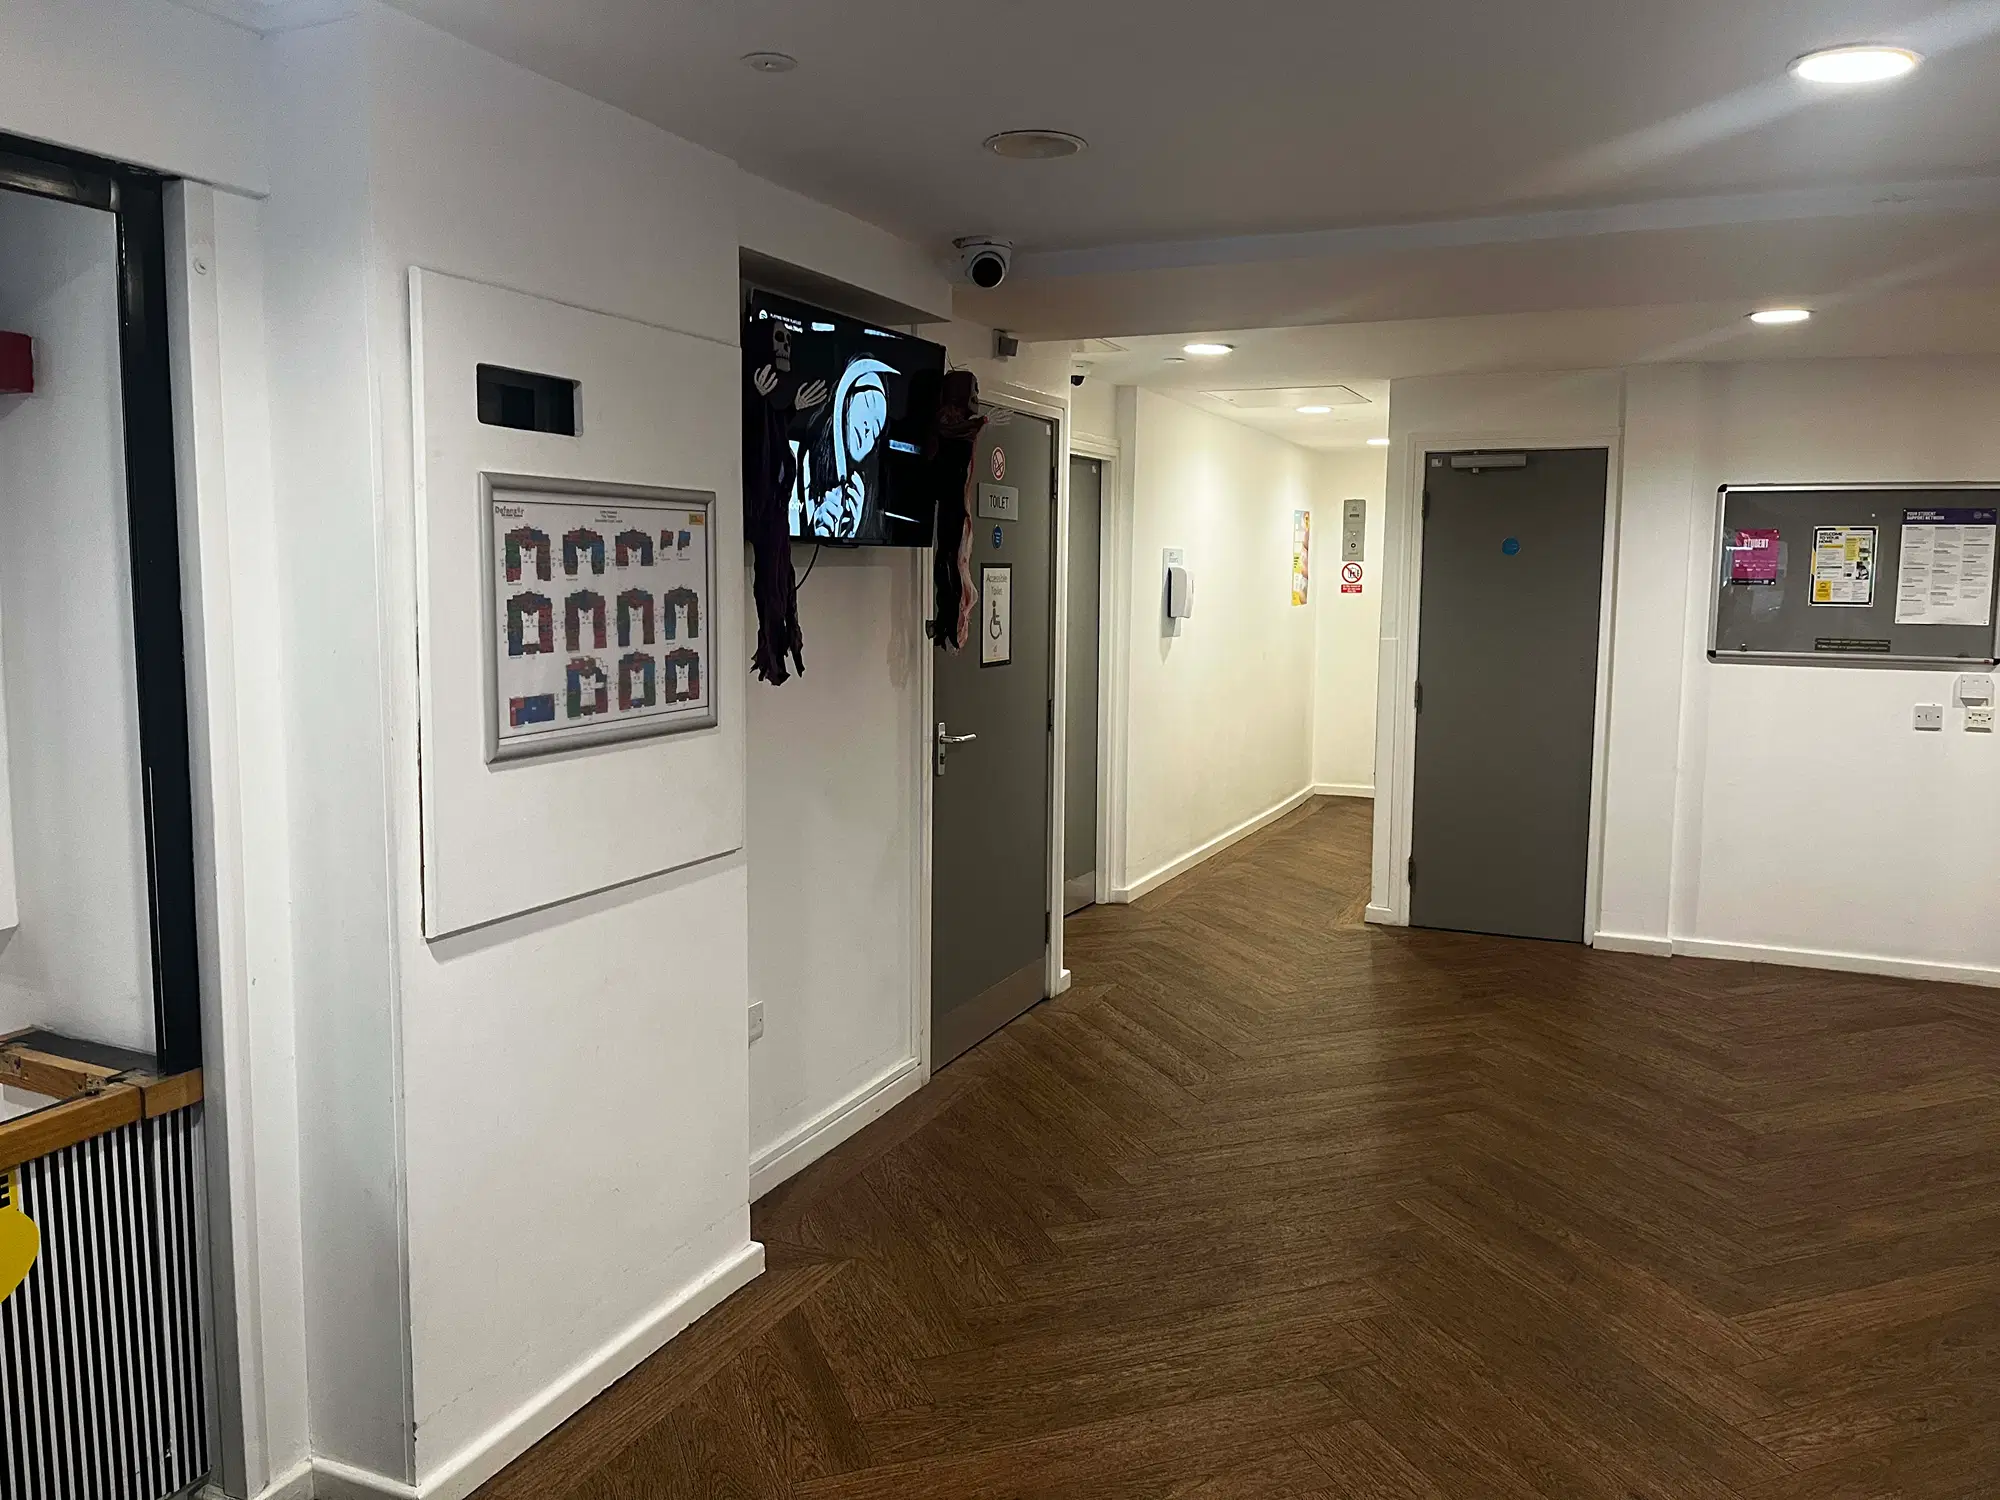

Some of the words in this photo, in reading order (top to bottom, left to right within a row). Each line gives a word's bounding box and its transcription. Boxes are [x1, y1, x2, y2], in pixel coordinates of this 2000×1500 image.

[989, 494, 1009, 509] TOILET
[1743, 538, 1769, 548] STUDENT
[985, 572, 1008, 583] Accessible
